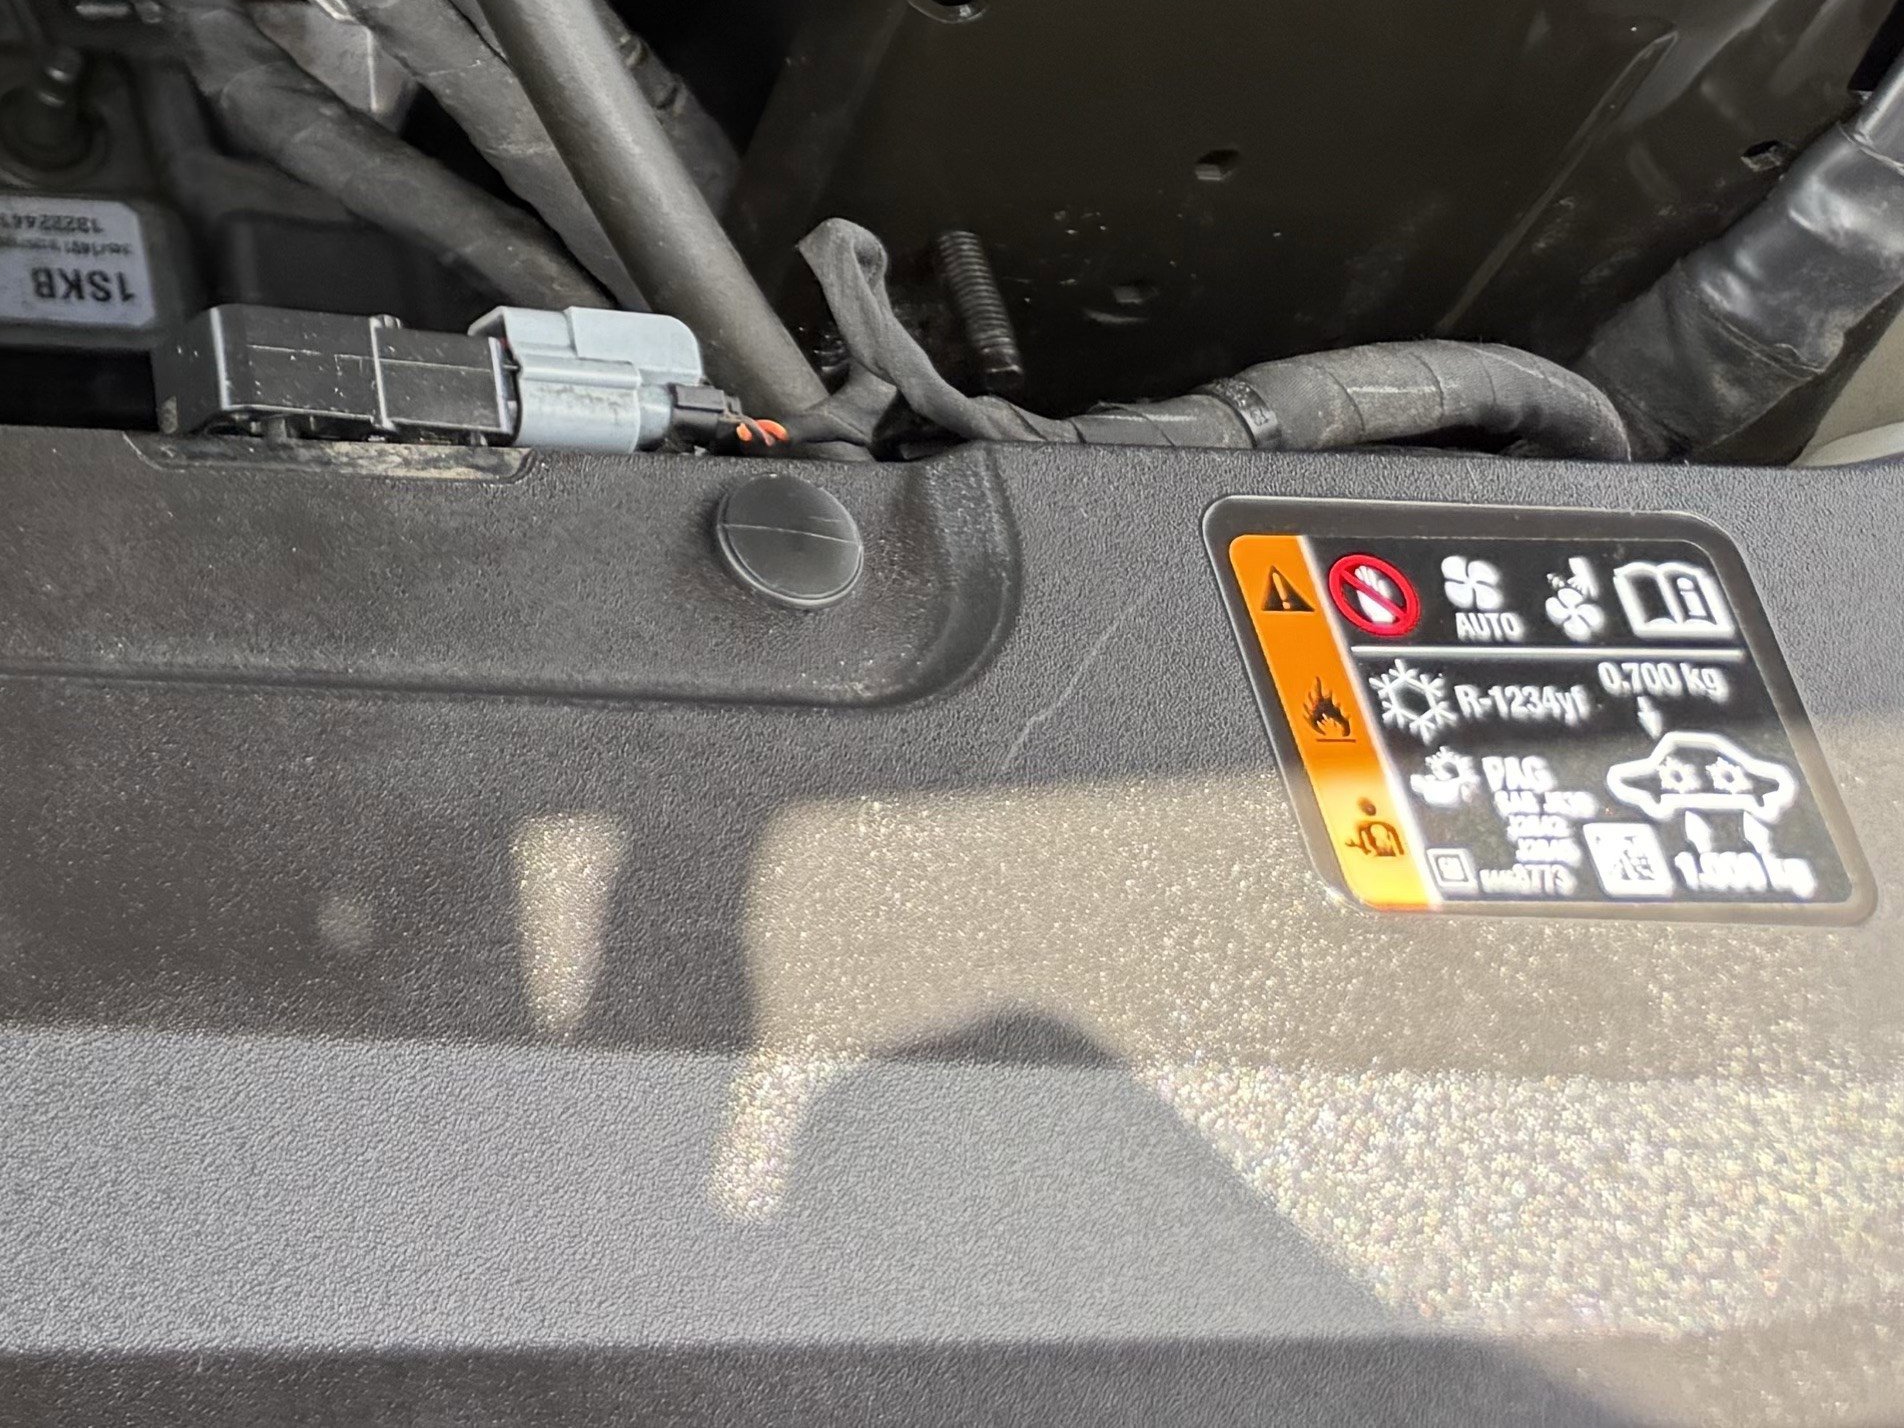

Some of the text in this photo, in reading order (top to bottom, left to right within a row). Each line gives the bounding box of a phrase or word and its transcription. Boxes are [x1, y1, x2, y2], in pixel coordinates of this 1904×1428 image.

[30, 267, 136, 303] 1SKB
[1454, 611, 1524, 641] AUTO
[1599, 661, 1727, 699] 0.700 kg
[1454, 684, 1588, 722] R-1234yf
[1482, 756, 1555, 793] PAG
